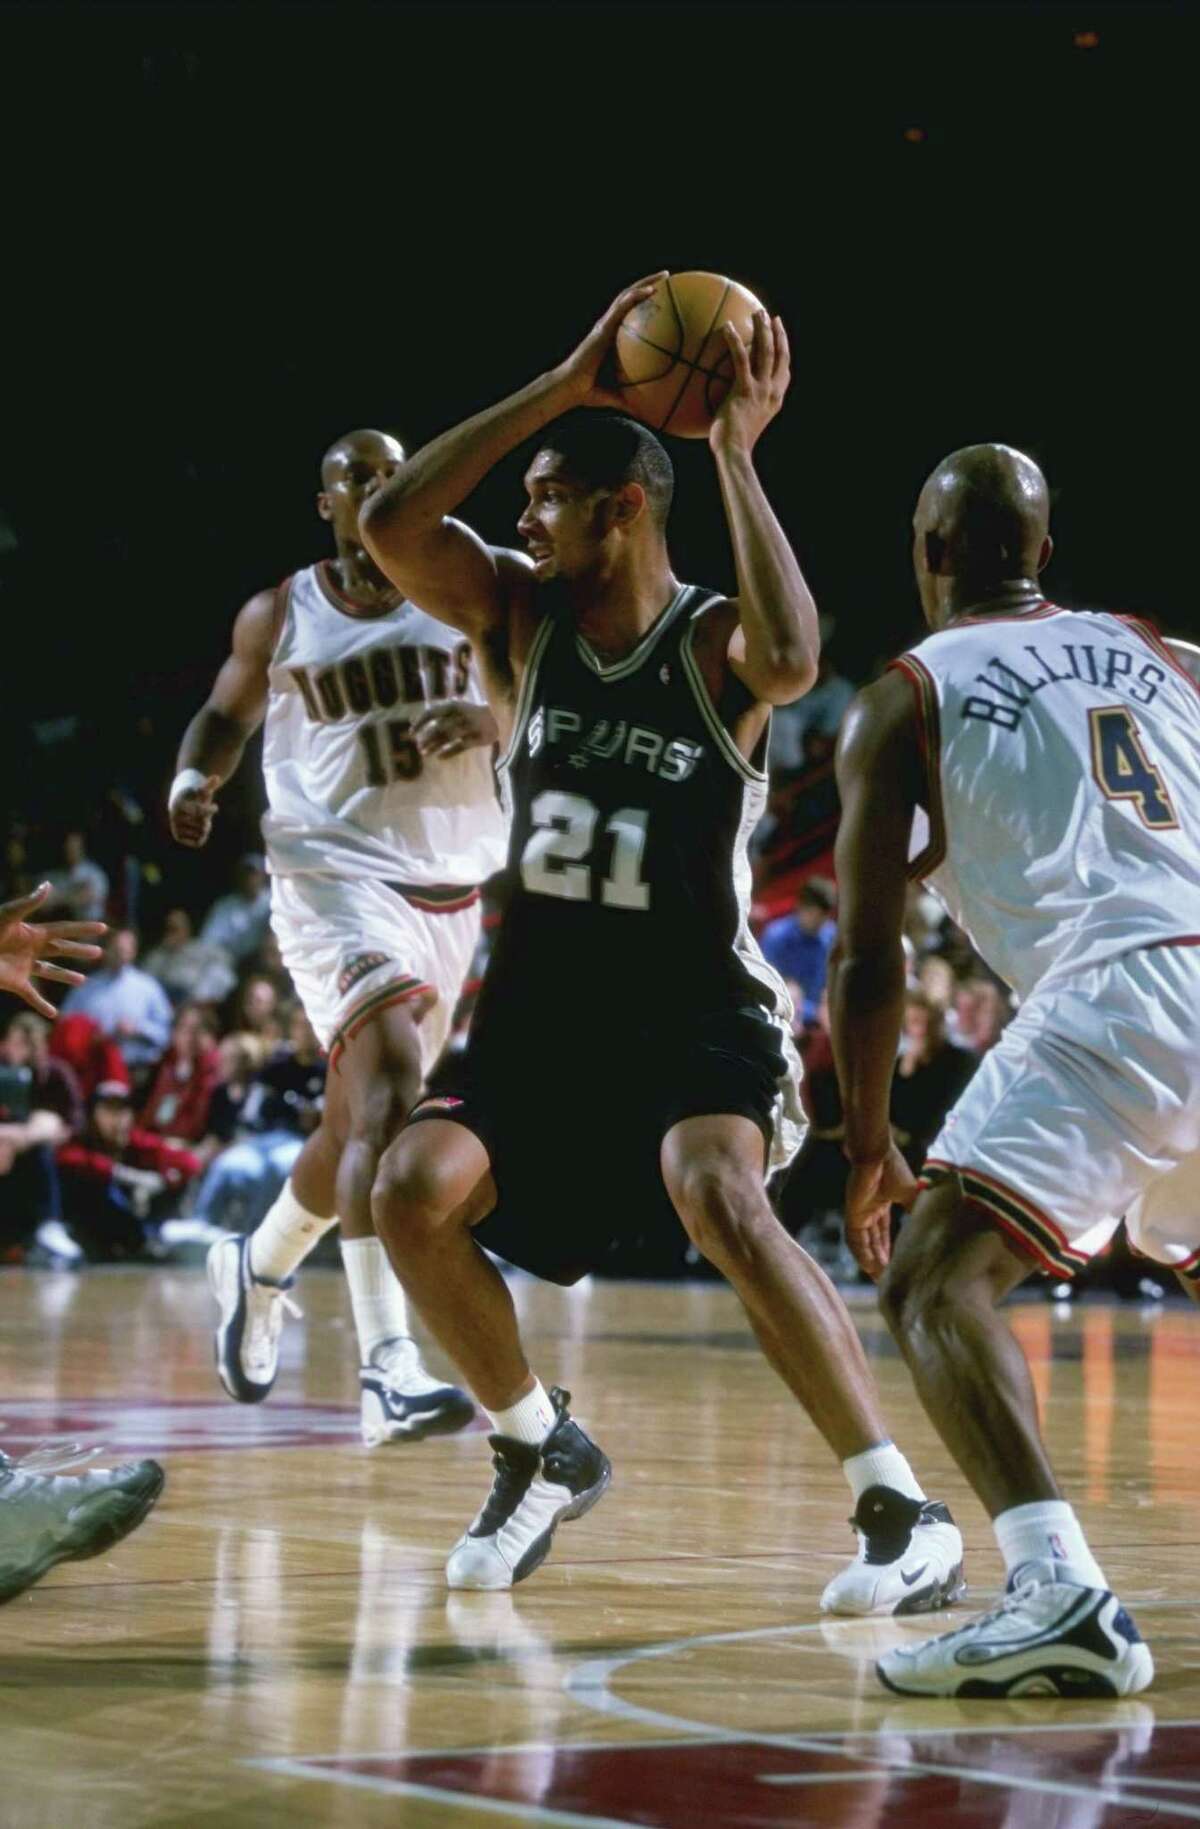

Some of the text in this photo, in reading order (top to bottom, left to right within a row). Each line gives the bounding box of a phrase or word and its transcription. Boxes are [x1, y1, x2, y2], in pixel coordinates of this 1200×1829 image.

[961, 644, 1165, 732] BILLUPS
[356, 719, 423, 786] 15
[527, 705, 703, 782] SPURS
[1086, 704, 1180, 830] 4
[520, 789, 649, 911] 21
